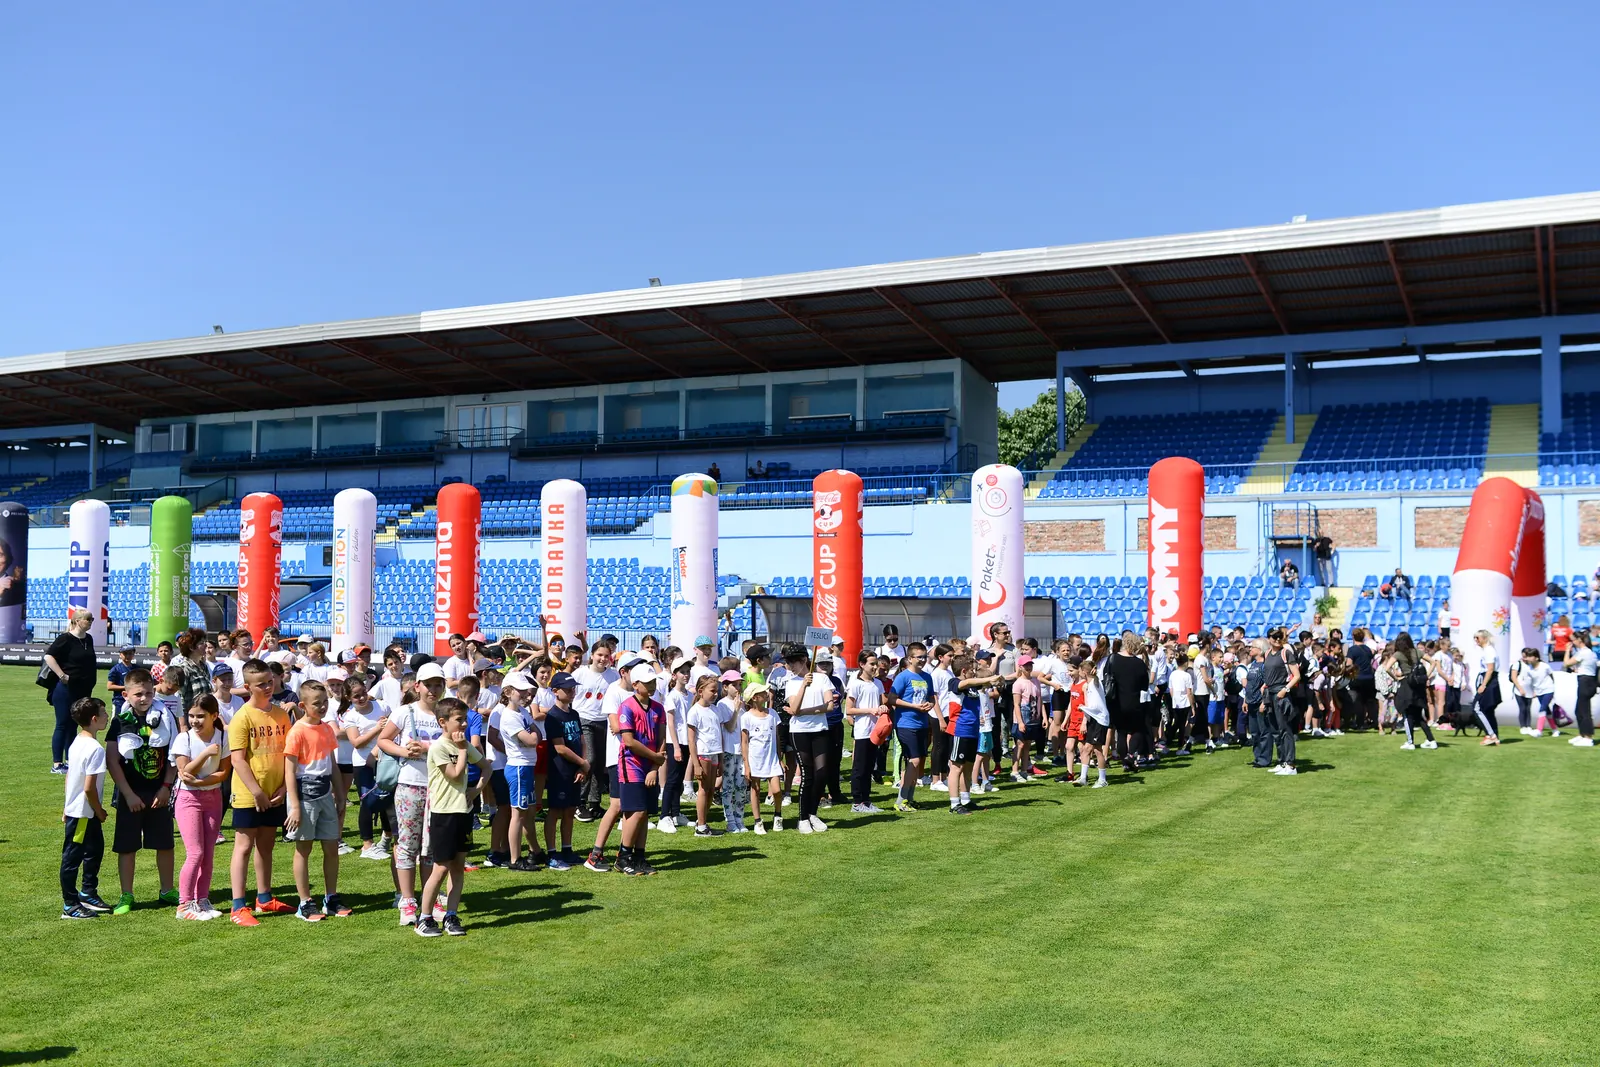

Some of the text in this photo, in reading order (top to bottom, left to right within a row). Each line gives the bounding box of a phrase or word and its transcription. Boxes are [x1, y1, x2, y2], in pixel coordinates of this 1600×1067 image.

[239, 552, 249, 589] CUP
[335, 528, 346, 635] FOUNDATION
[435, 521, 453, 640] plazma
[546, 504, 565, 624] PODRAVKA
[819, 544, 836, 590] CUP
[979, 548, 996, 591] Paket
[1150, 497, 1179, 634] TOMMY
